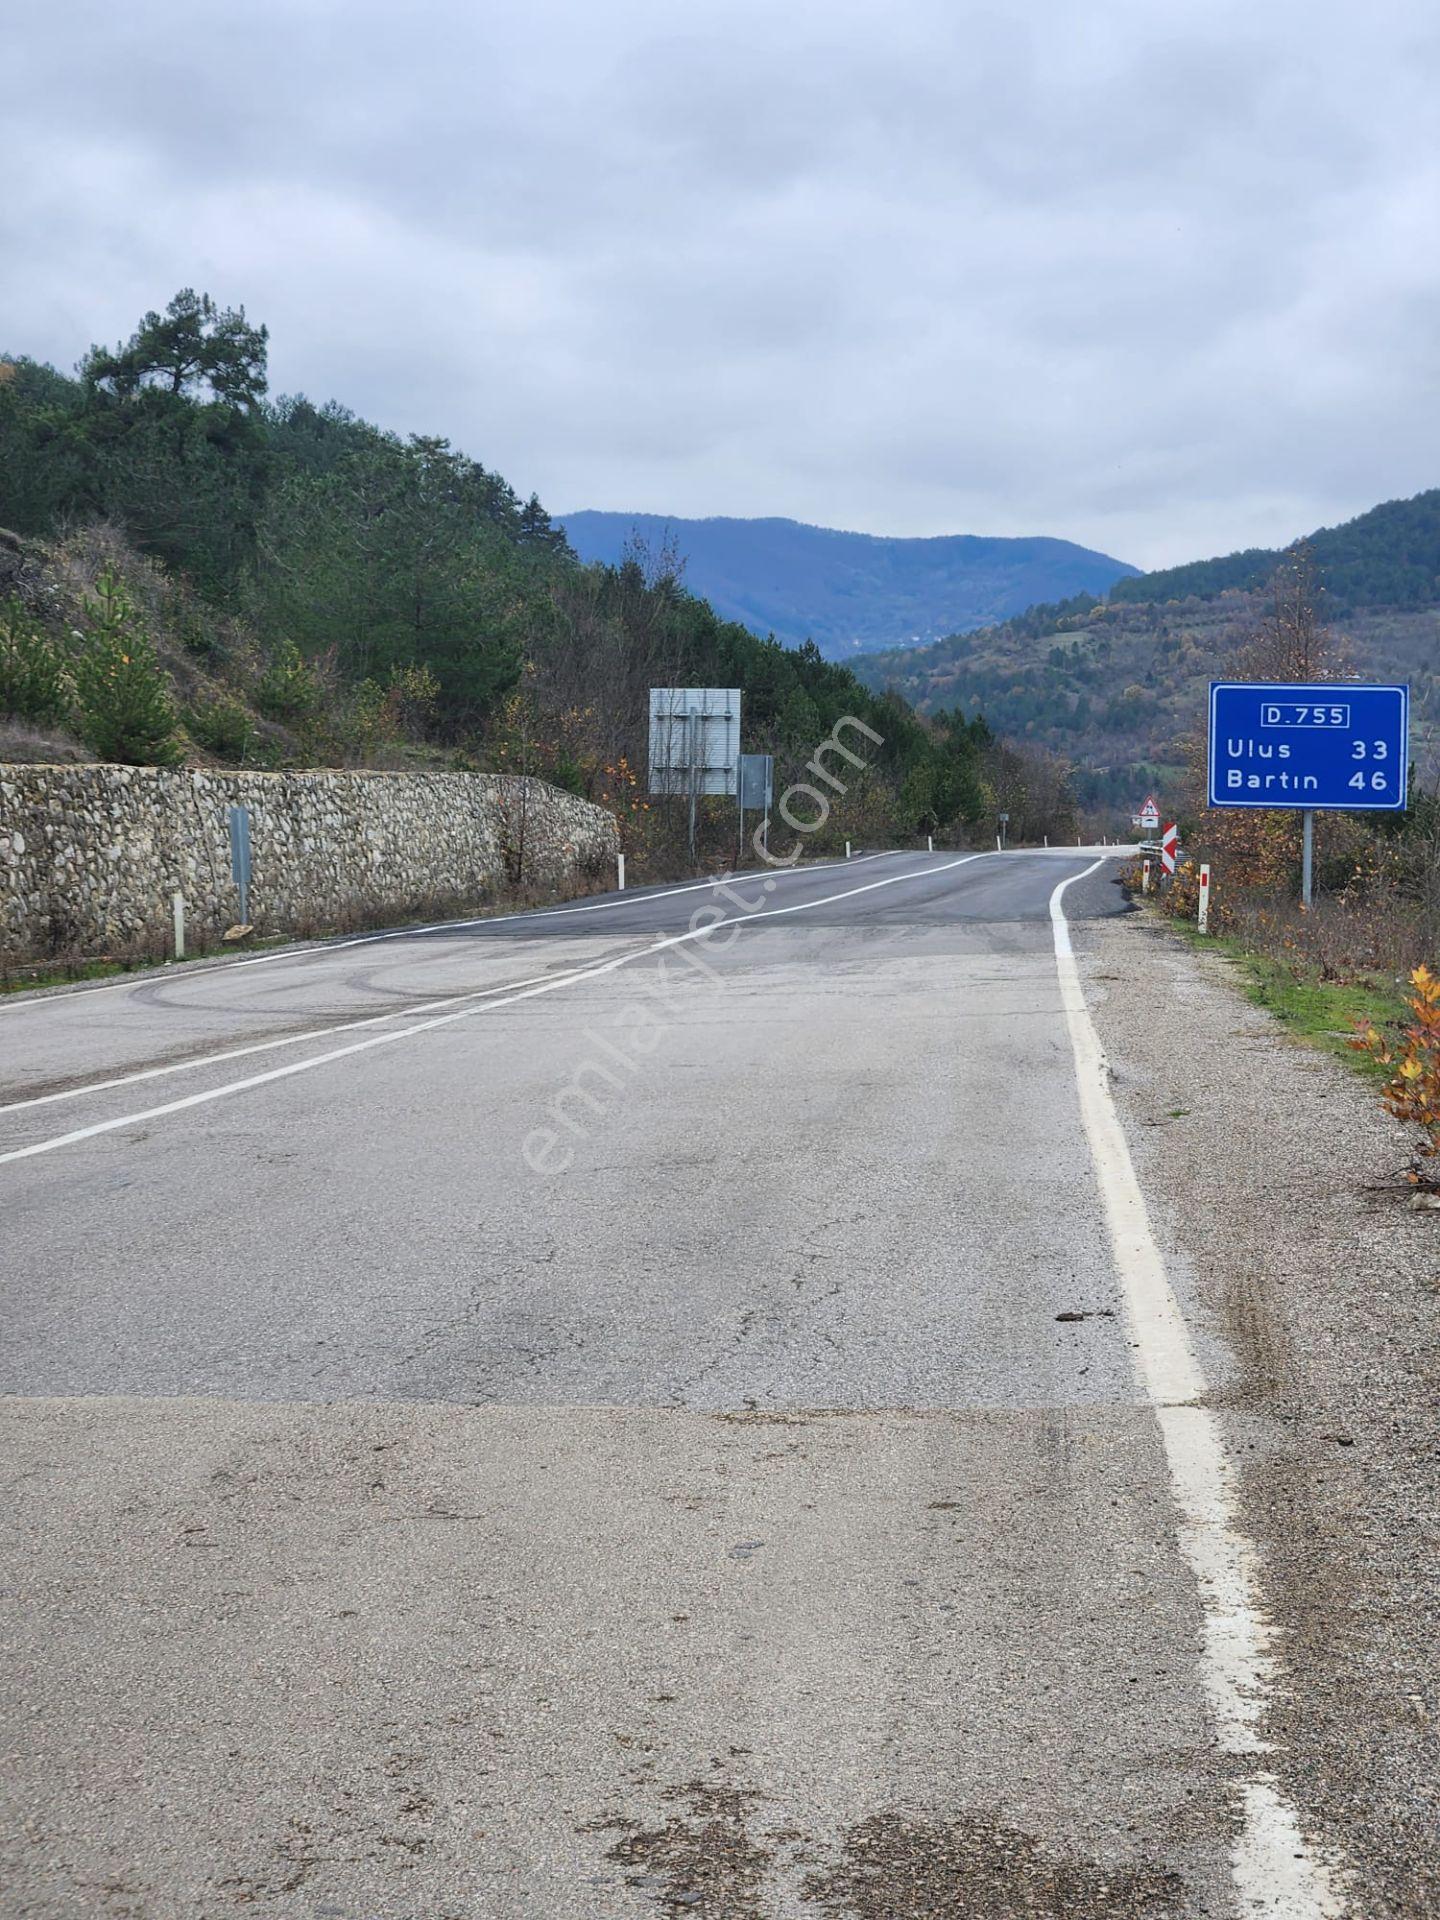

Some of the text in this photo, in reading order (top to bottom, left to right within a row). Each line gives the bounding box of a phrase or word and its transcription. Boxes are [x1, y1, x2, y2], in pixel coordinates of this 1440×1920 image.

[1267, 707, 1343, 724] D.755
[1227, 739, 1388, 760] Ulus 33
[1227, 769, 1388, 791] Bartın 46
